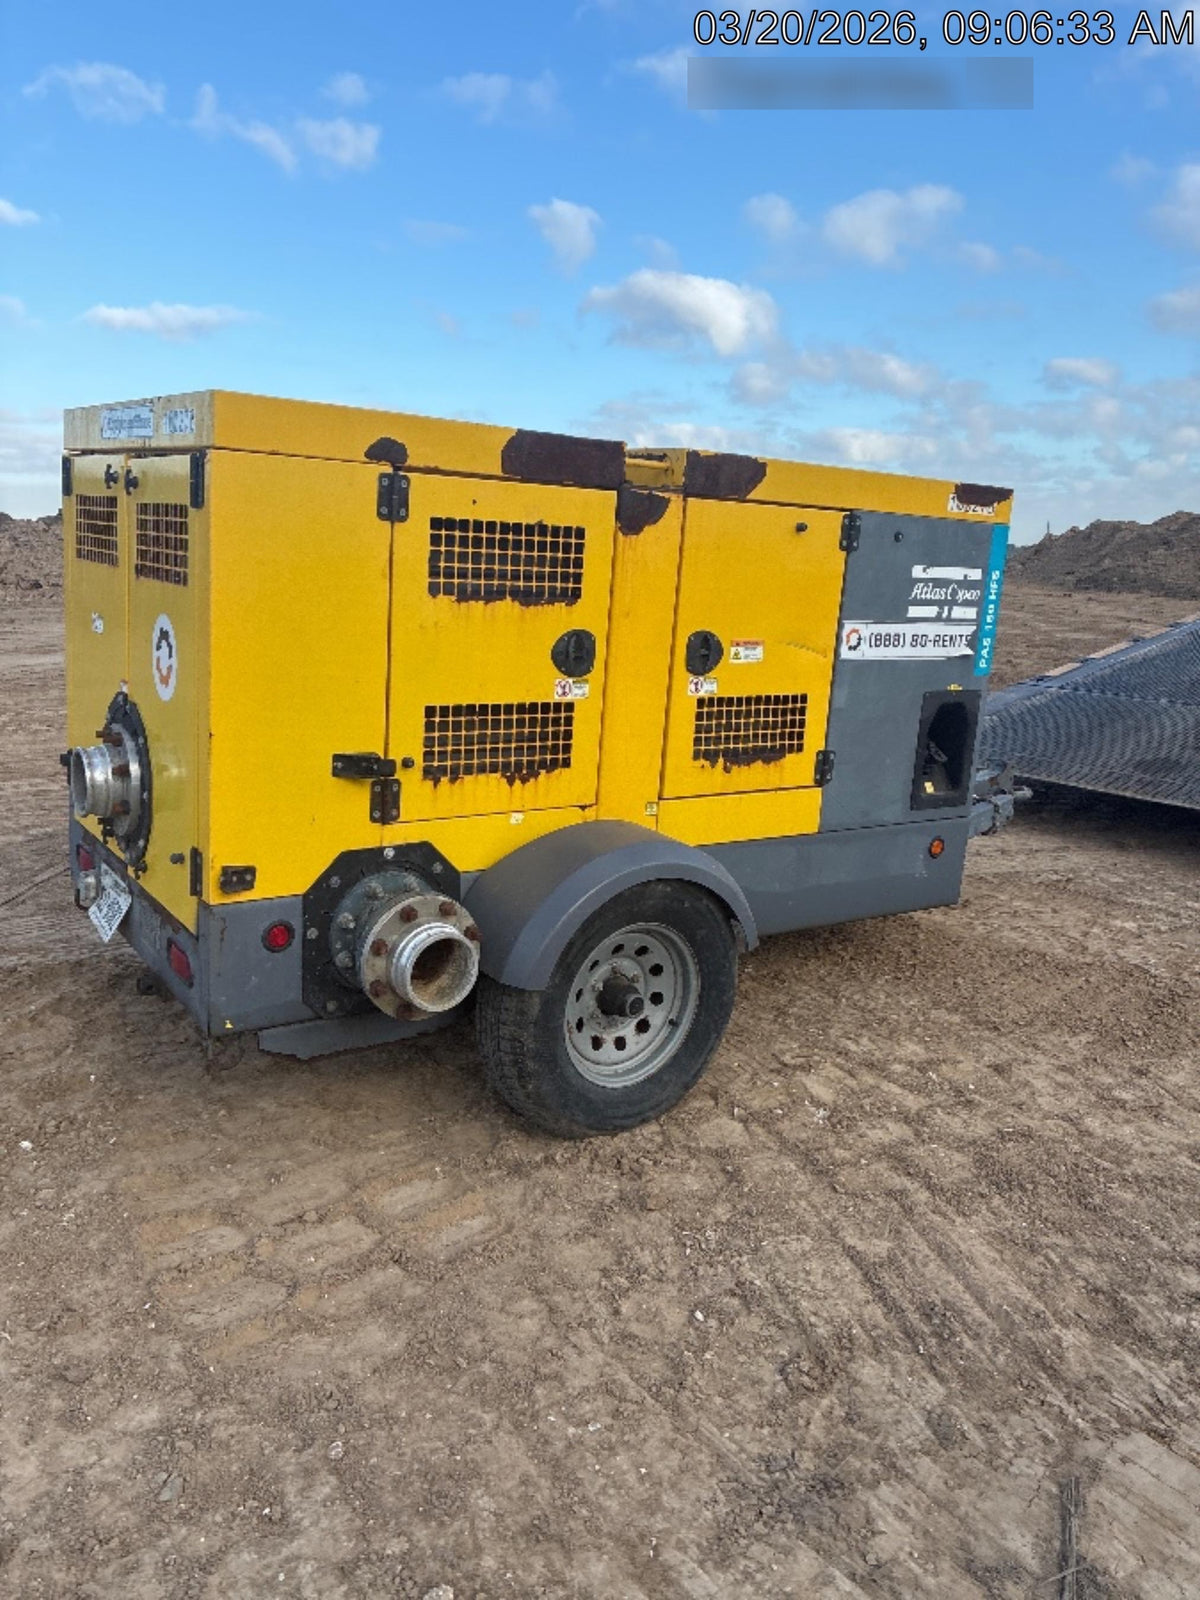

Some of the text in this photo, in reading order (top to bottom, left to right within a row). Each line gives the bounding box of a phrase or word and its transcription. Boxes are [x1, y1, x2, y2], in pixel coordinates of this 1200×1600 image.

[908, 582, 946, 600] Atlas
[869, 632, 906, 648] (888)
[979, 637, 992, 668] PAS
